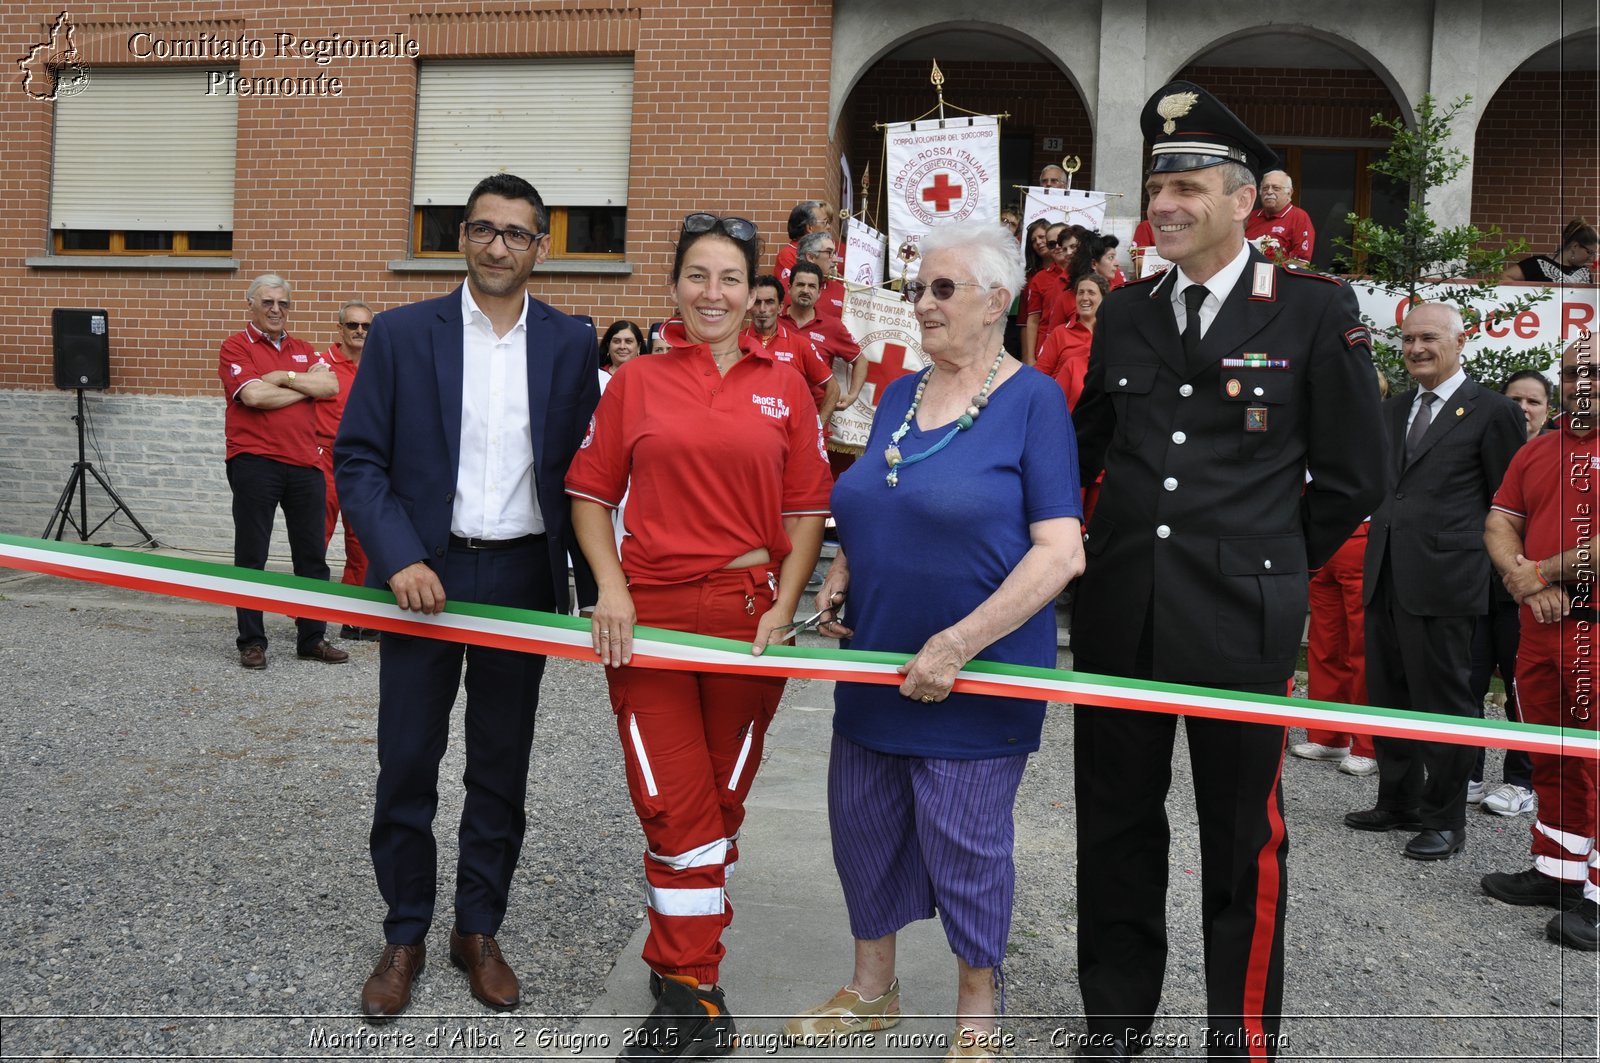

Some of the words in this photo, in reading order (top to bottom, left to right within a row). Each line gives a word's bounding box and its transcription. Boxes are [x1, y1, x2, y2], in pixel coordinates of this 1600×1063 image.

[893, 138, 914, 146] CORPO
[914, 134, 946, 144] VOLONTARI
[961, 130, 993, 139] SOCCORSO
[1047, 139, 1058, 149] 33
[893, 159, 918, 190] CROCE
[917, 147, 953, 161] ROSSA
[956, 149, 990, 184] ITALIANA
[915, 169, 924, 179] DI
[924, 160, 957, 171] GINEVRA
[958, 166, 970, 176] 22
[966, 177, 977, 207] AGOSTO
[907, 178, 934, 224] CONVENZIONE
[849, 296, 871, 309] CORPO
[872, 301, 906, 316] VOLONTARI
[907, 310, 917, 320] DE
[845, 306, 876, 322] CROCE
[879, 316, 912, 329] ROSSA
[859, 330, 903, 349] NVENZIONE
[752, 393, 776, 407] CROCE
